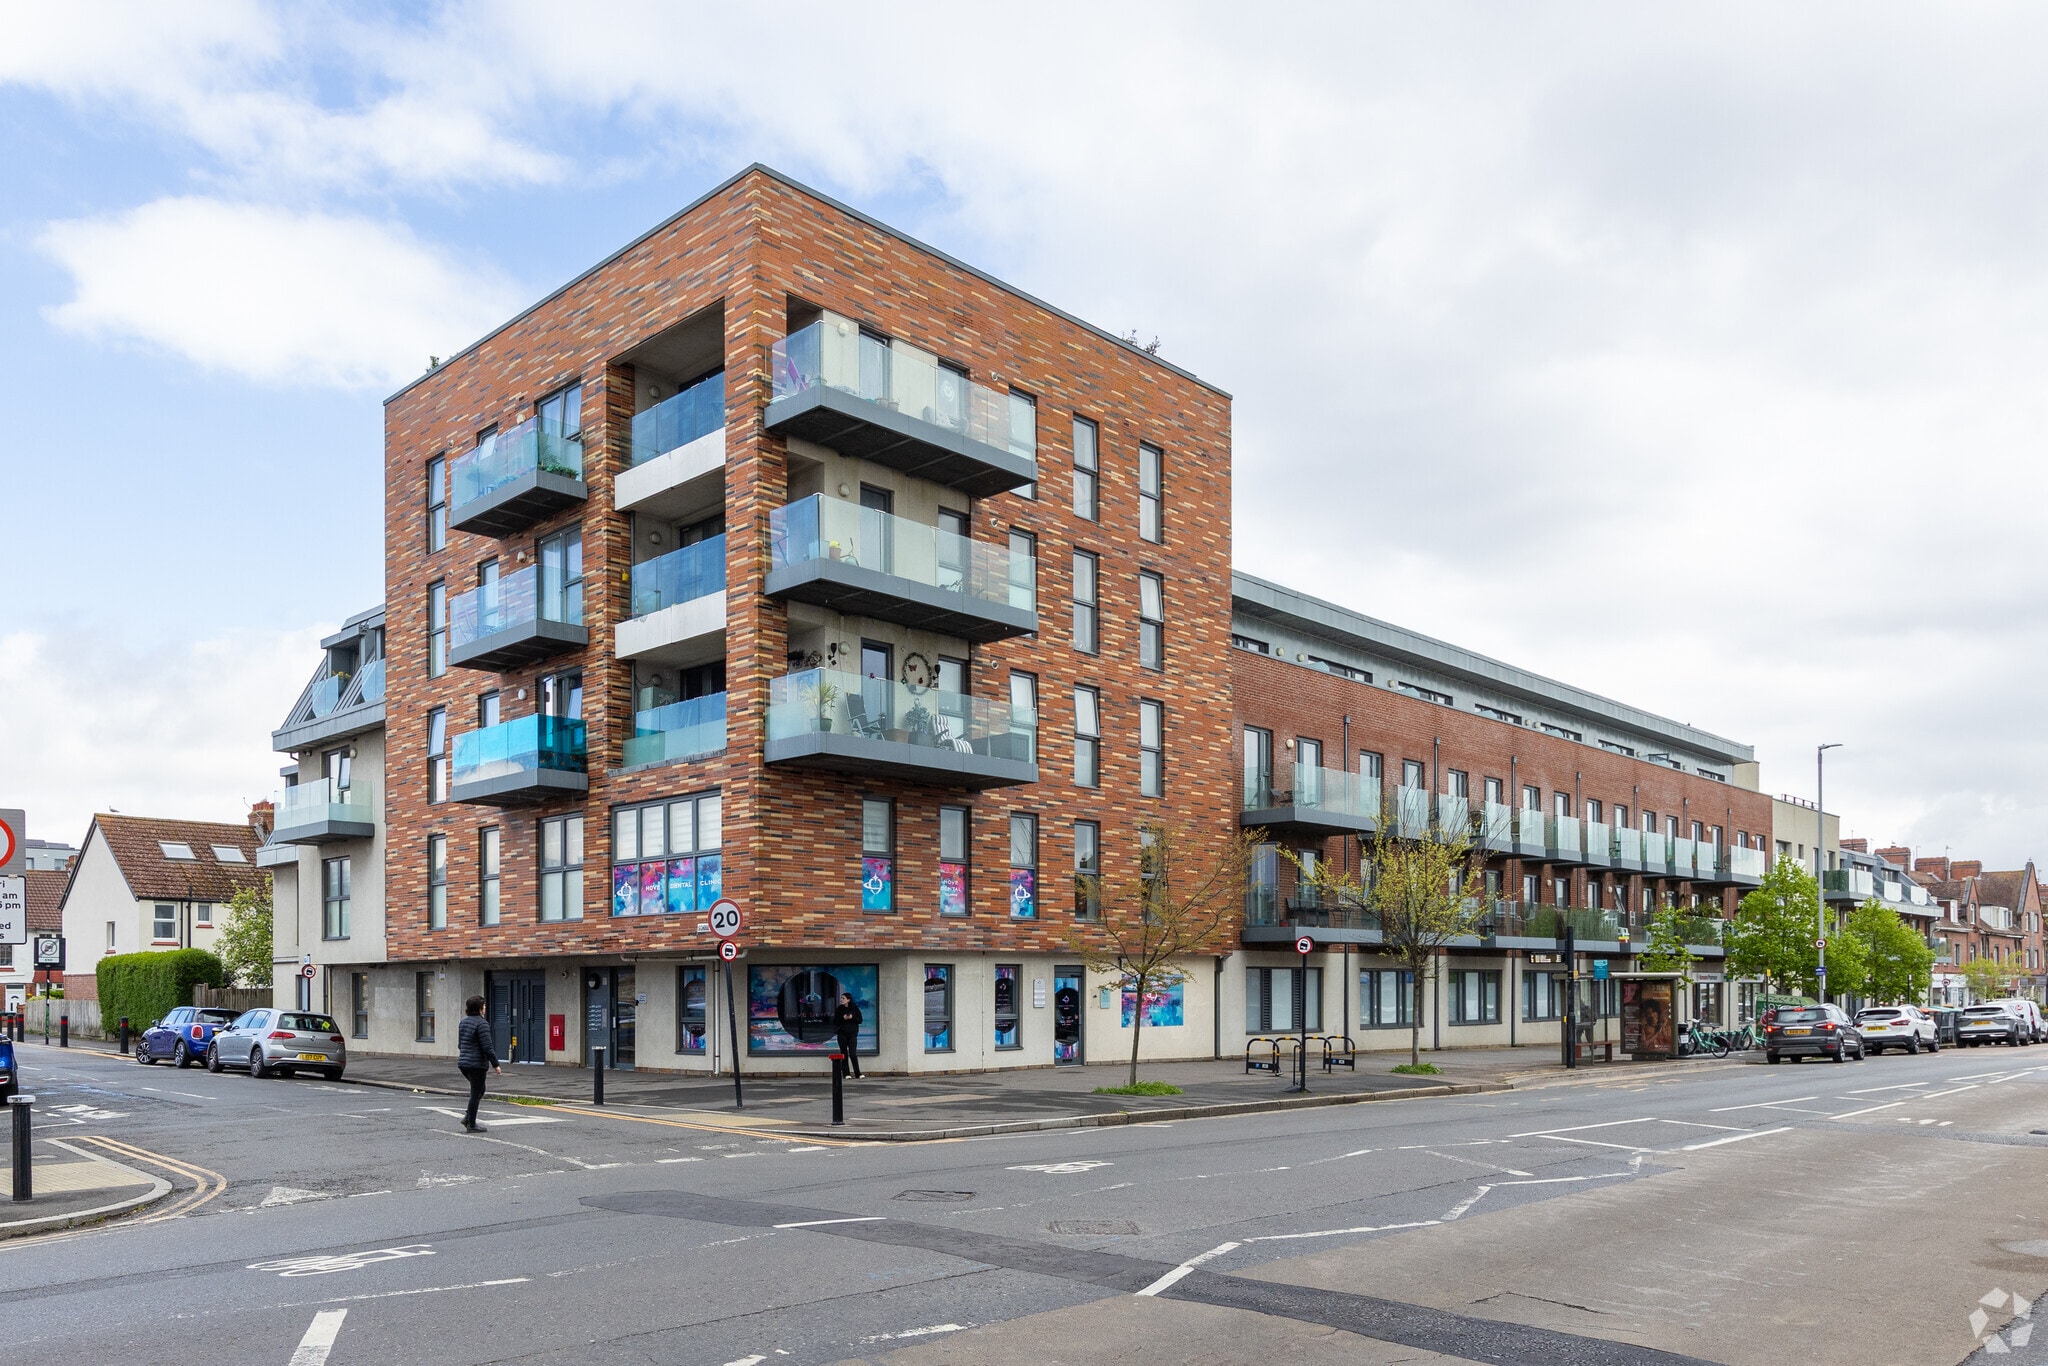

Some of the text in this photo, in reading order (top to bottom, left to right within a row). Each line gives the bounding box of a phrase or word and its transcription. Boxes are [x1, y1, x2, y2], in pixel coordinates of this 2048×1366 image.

[700, 878, 722, 887] CLINIC
[5, 902, 21, 910] pm
[713, 910, 739, 929] 20
